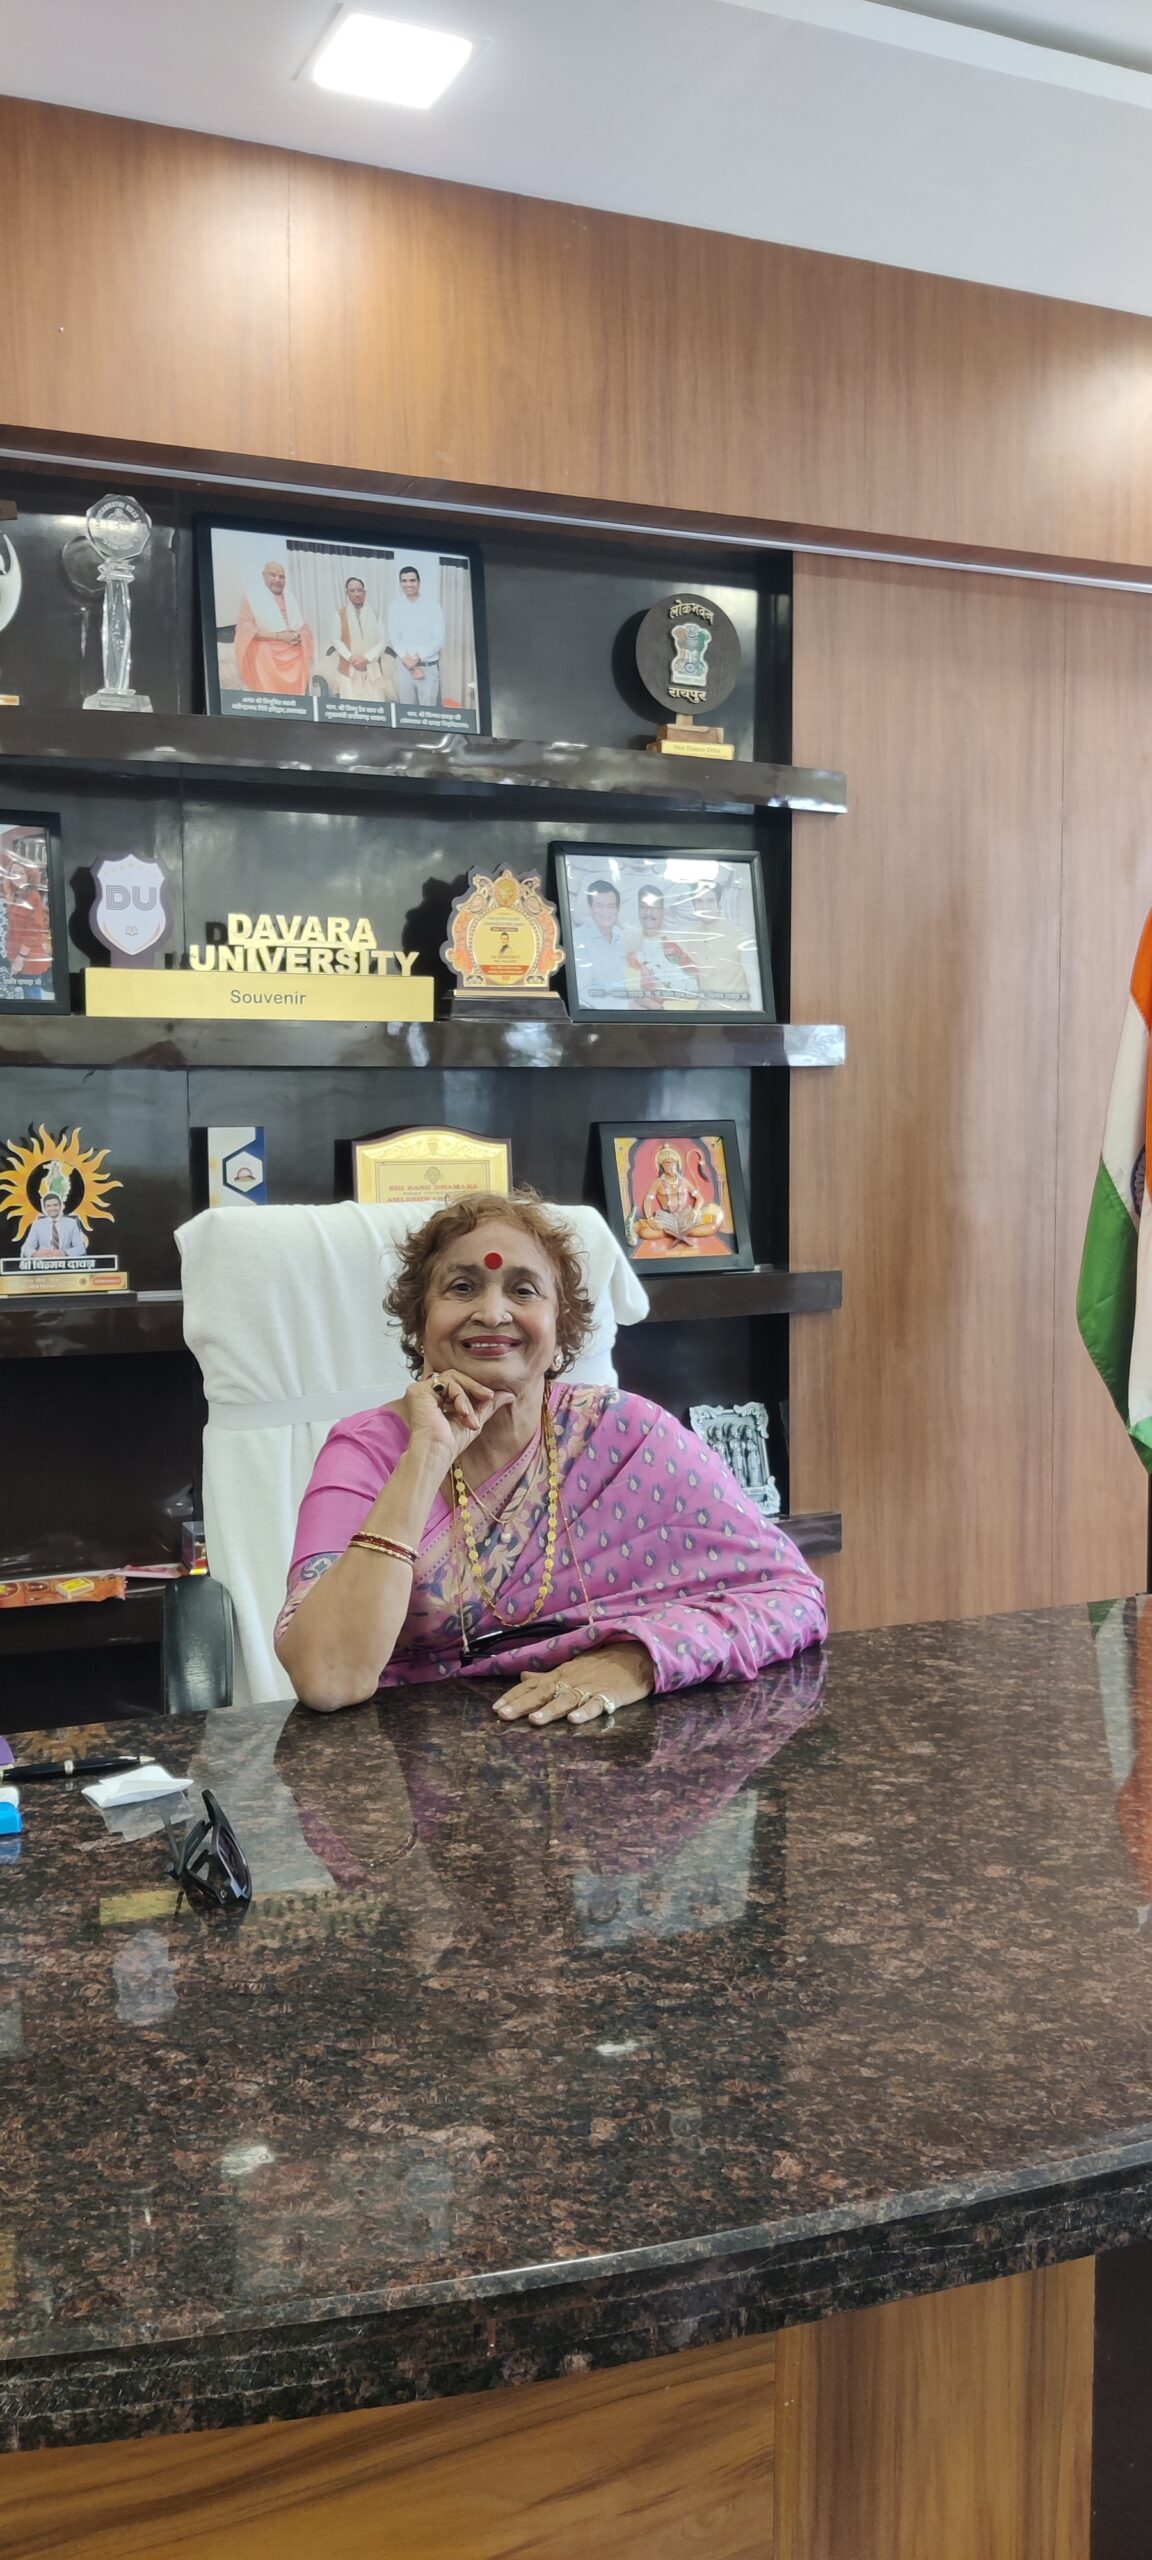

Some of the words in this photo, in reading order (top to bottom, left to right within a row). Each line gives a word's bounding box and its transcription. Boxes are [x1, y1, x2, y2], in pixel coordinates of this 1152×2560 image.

[668, 687, 707, 703] रायपुर
[106, 885, 157, 911] DU
[227, 913, 378, 949] DAVARA
[189, 945, 420, 976] UNIVERSITY
[230, 989, 307, 1005] Souvenir
